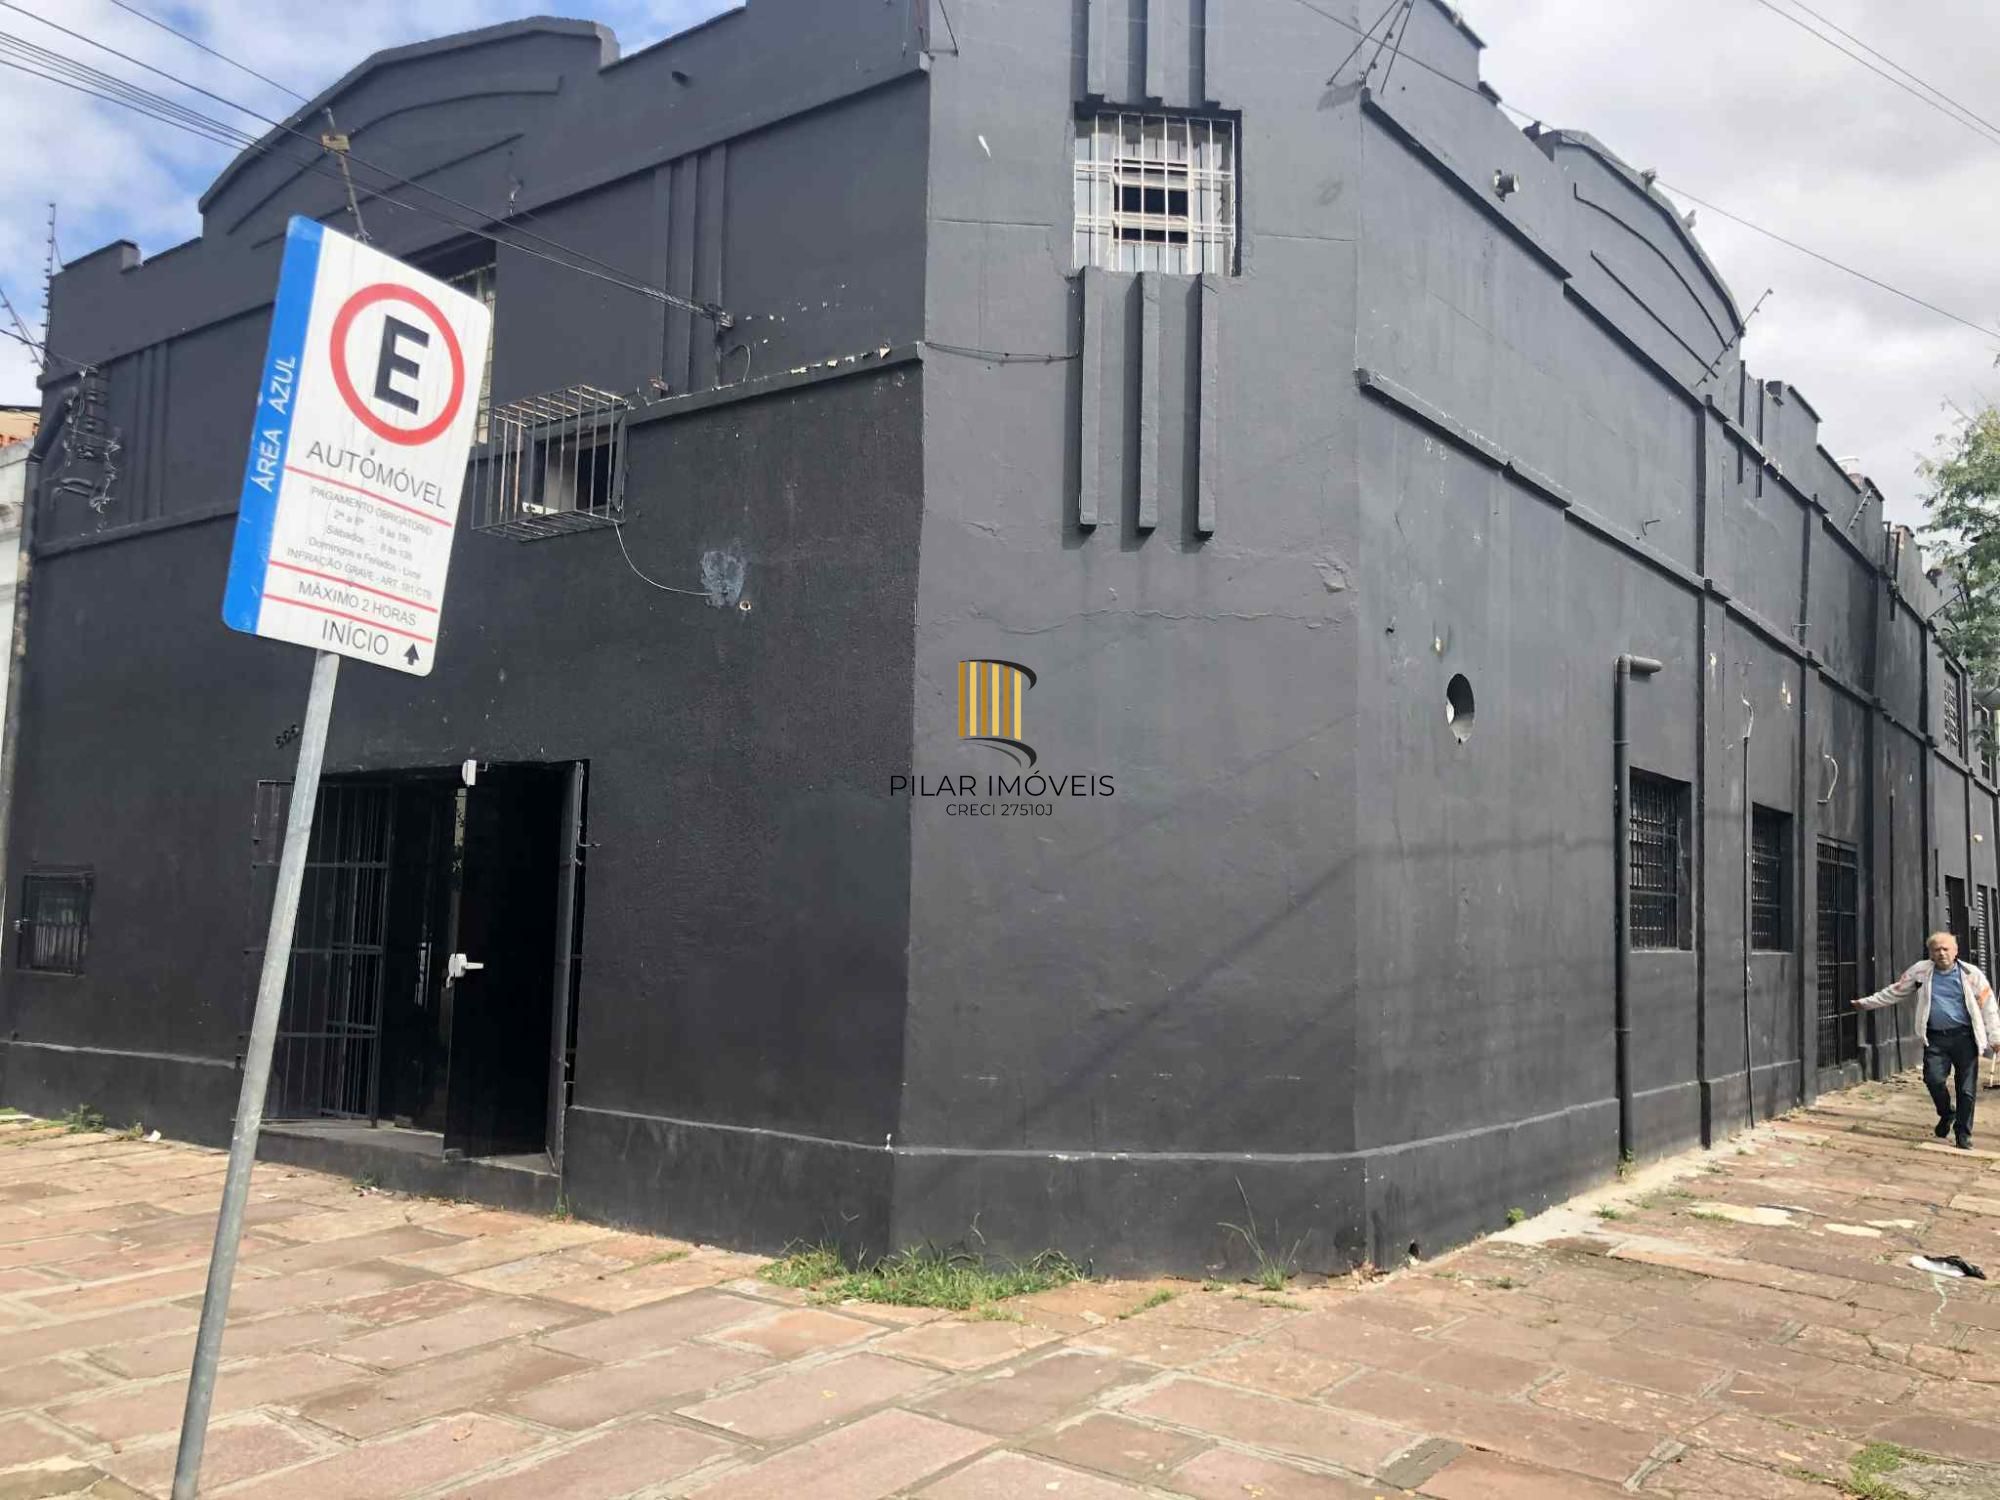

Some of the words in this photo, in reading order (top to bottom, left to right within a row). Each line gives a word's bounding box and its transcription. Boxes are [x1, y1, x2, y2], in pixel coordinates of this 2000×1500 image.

[374, 314, 429, 415] E
[250, 429, 283, 493] ÁREA
[268, 355, 296, 415] AZUL
[306, 441, 446, 509] AUTOMÓVEL
[310, 486, 375, 514] PAGAMENTO
[308, 537, 355, 560] Domingos
[344, 563, 375, 582] GRAVE
[298, 581, 359, 608] MÁXIMO
[361, 599, 370, 612] 2
[372, 603, 417, 626] HORAS
[322, 619, 390, 656] INÍCIO
